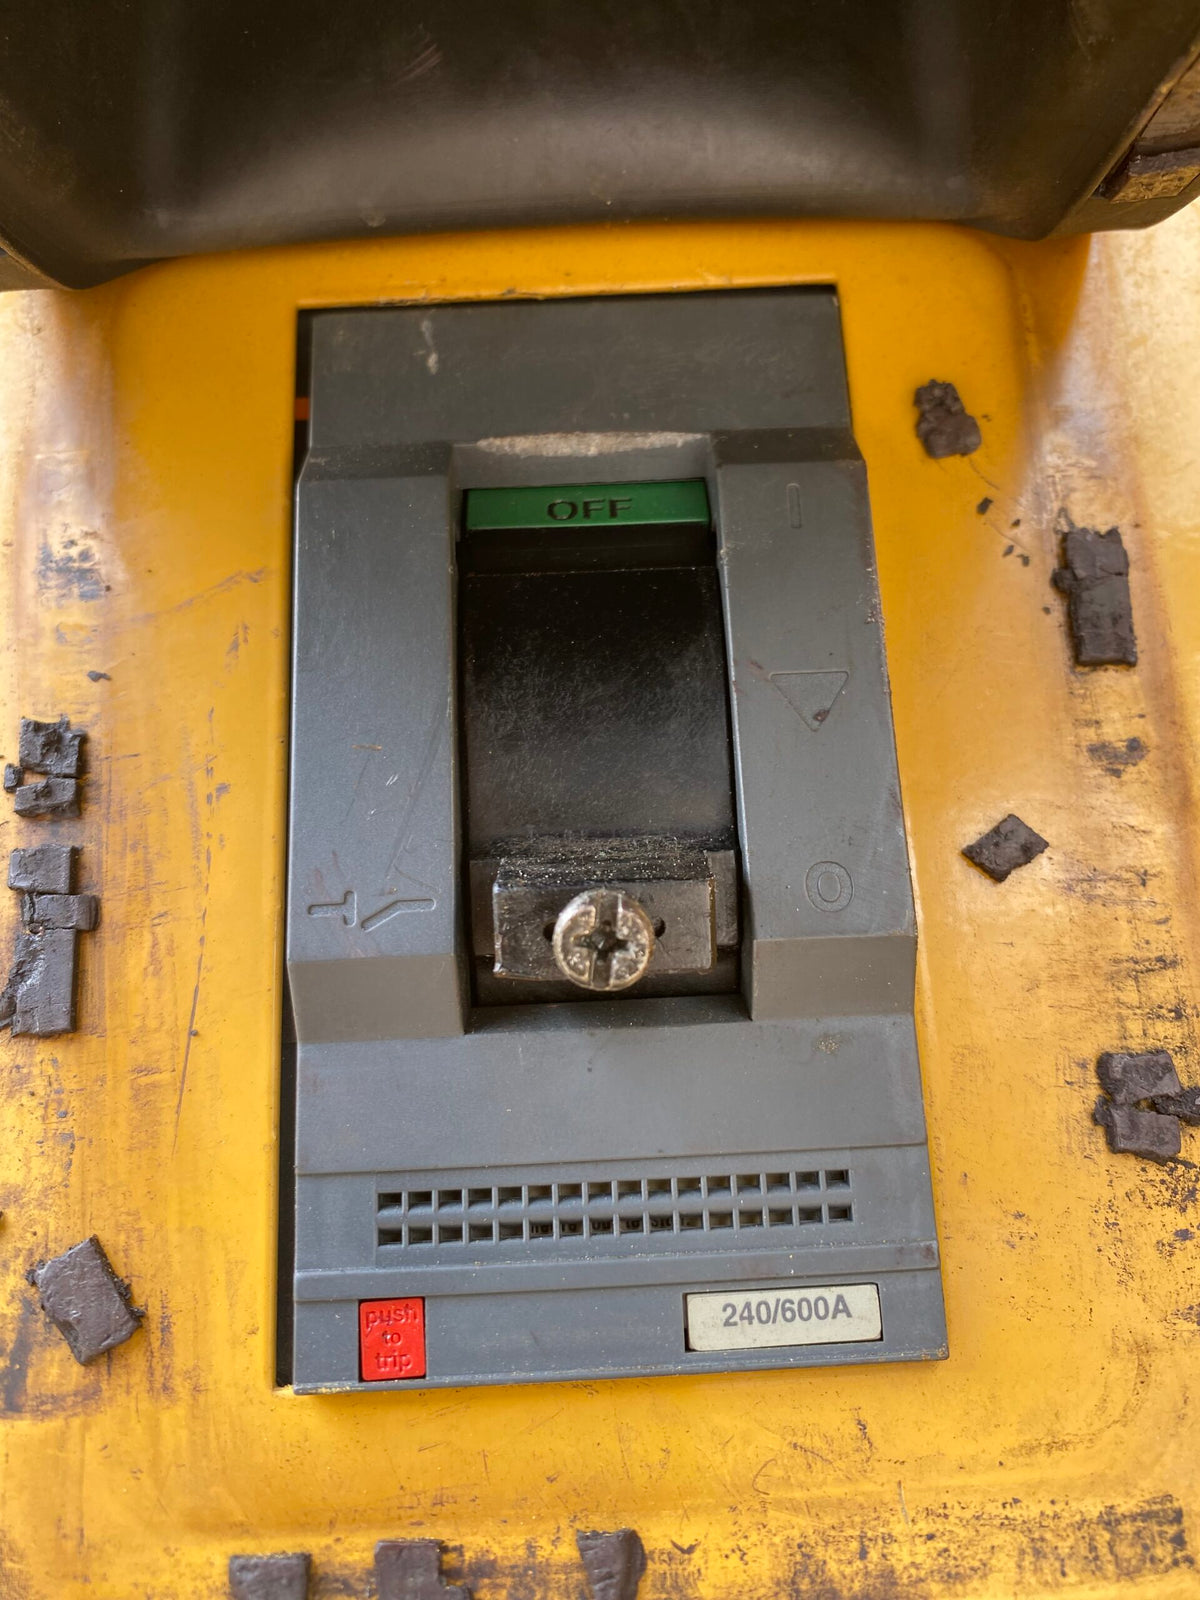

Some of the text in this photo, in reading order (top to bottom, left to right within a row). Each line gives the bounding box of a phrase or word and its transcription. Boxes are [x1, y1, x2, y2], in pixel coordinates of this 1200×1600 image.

[547, 497, 633, 522] OFF
[366, 1304, 418, 1333] push
[722, 1294, 853, 1328] 240/600A
[382, 1330, 402, 1346] to
[375, 1350, 413, 1374] trip
